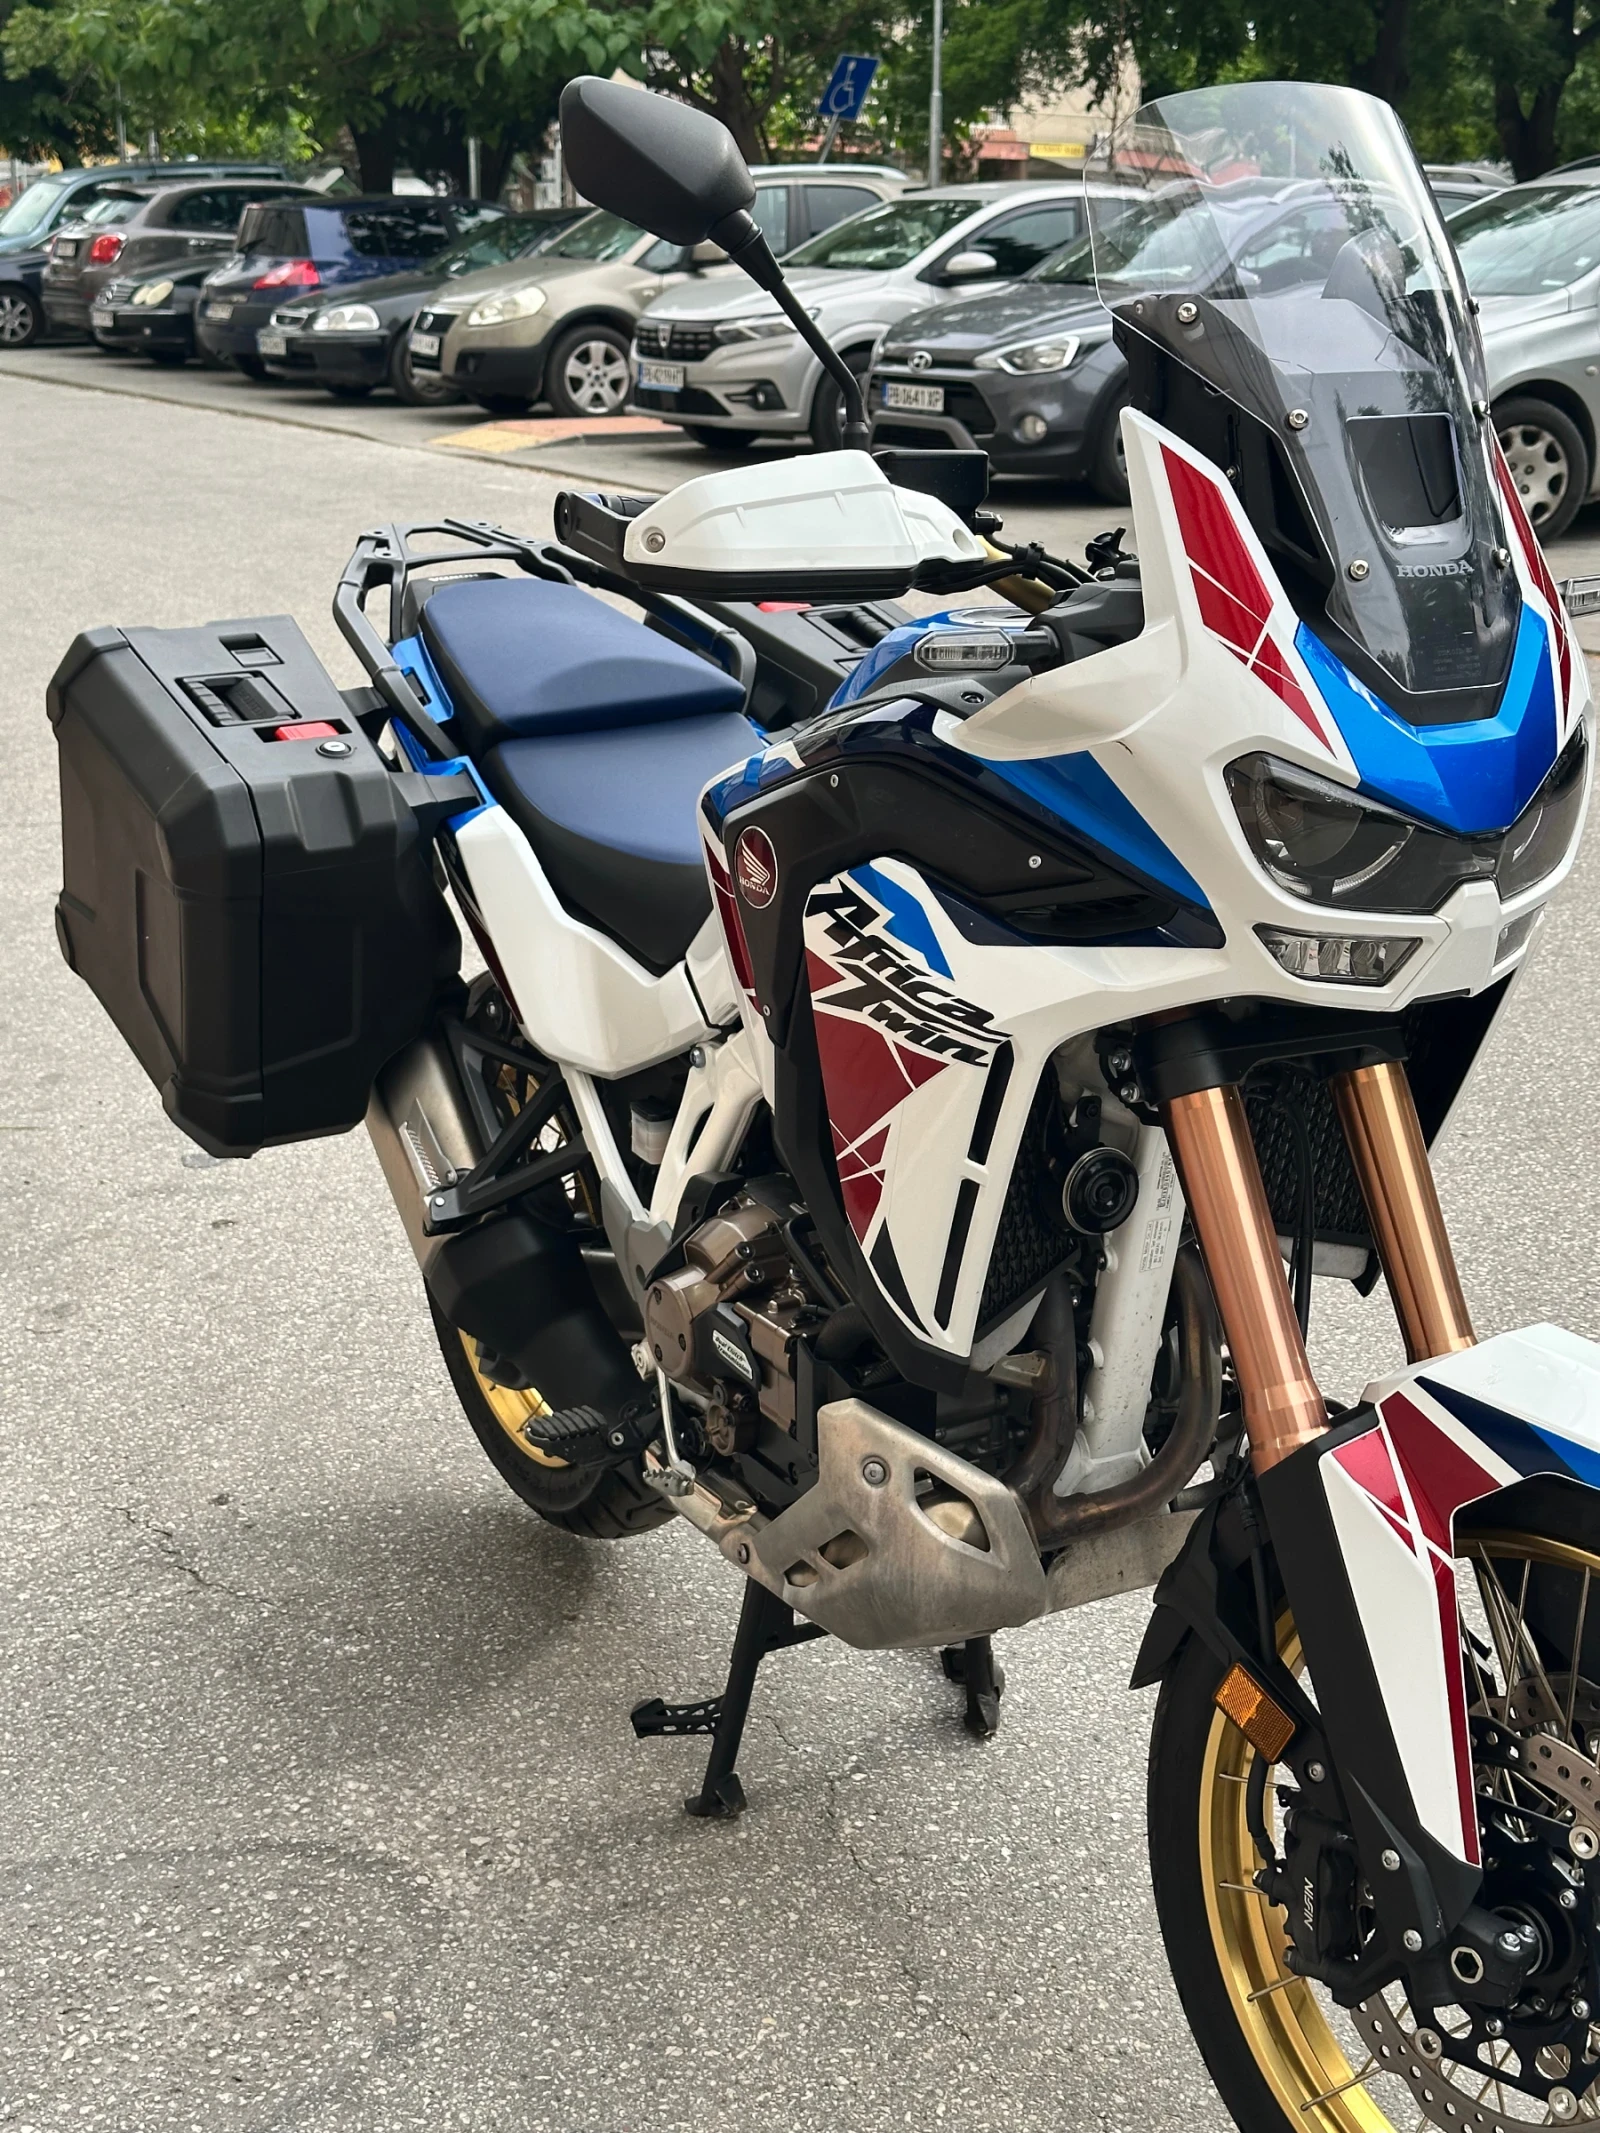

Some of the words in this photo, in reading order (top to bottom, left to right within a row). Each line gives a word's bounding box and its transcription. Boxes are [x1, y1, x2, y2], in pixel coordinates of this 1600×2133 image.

[1396, 560, 1475, 577] HONDA
[740, 875, 770, 896] HONDA
[805, 877, 1013, 1038] Africa
[814, 961, 1004, 1067] Twin
[715, 1336, 728, 1348] Dual
[726, 1346, 745, 1362] Clutch
[717, 1344, 750, 1374] Transmission
[1303, 1876, 1314, 1932] NISSIN
